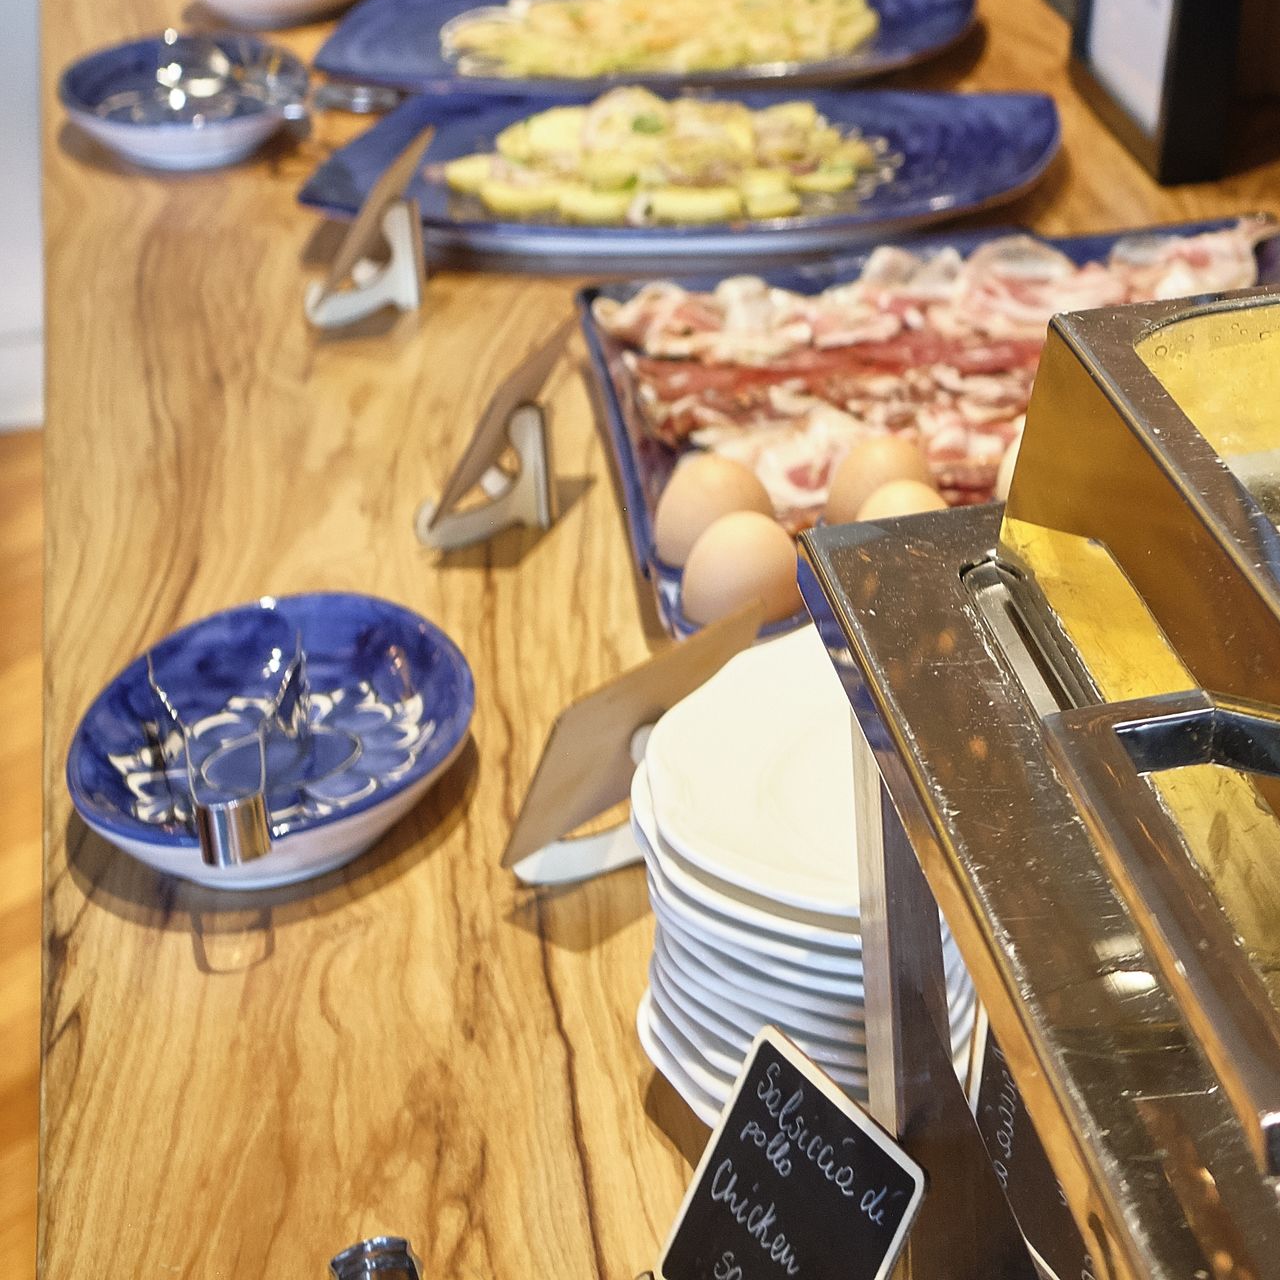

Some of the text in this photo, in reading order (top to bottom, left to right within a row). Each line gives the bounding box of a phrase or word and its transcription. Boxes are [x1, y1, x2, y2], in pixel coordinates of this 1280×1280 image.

[738, 1119, 794, 1178] pollo
[756, 1061, 903, 1227] Salsiccia di
[710, 1157, 801, 1276] Chicken
